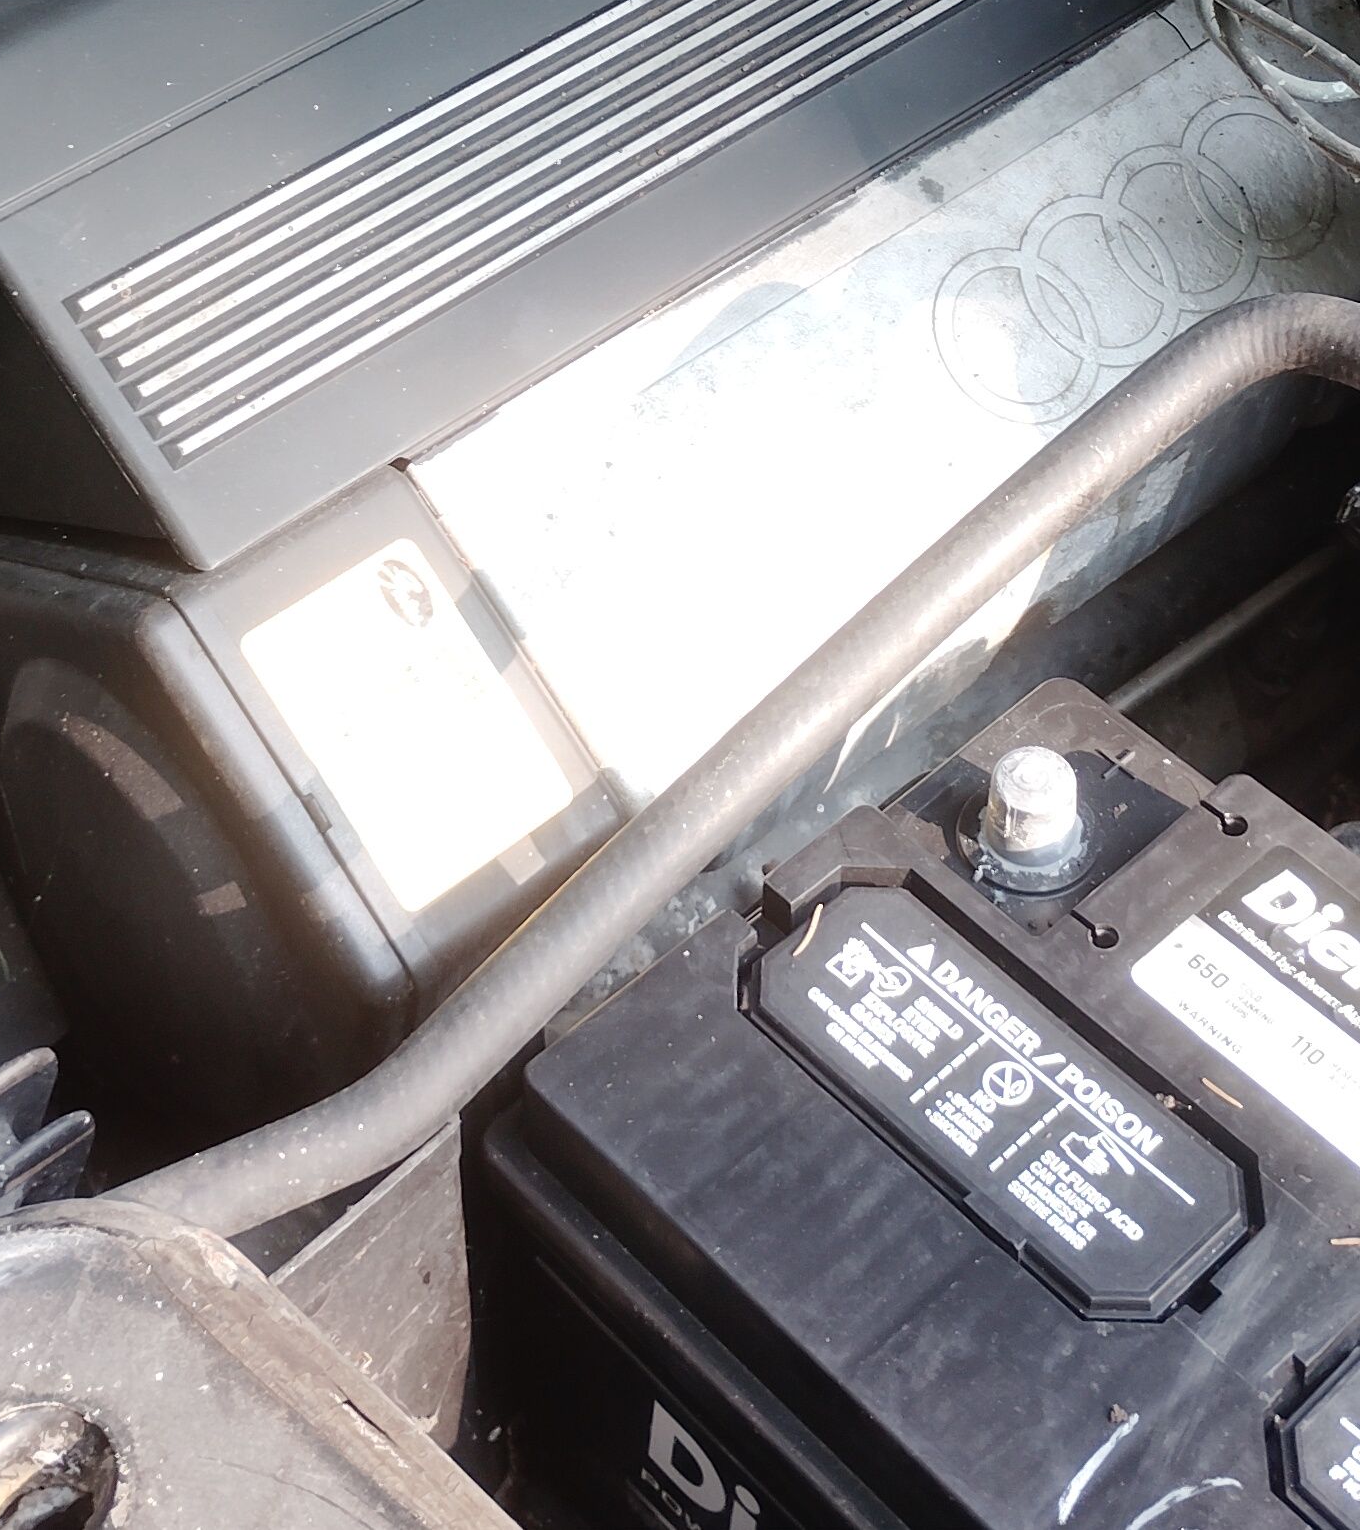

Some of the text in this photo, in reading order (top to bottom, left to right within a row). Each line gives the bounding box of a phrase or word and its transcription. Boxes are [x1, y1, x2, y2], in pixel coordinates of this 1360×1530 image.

[1188, 955, 1229, 987] 650
[1292, 1034, 1325, 1065] 110
[970, 1089, 996, 1113] NO
[1019, 1171, 1096, 1240] BLINDNESS OR
[1030, 1161, 1093, 1218] CAN CAUSE
[1041, 1151, 1143, 1240] SULFURIC ACID
